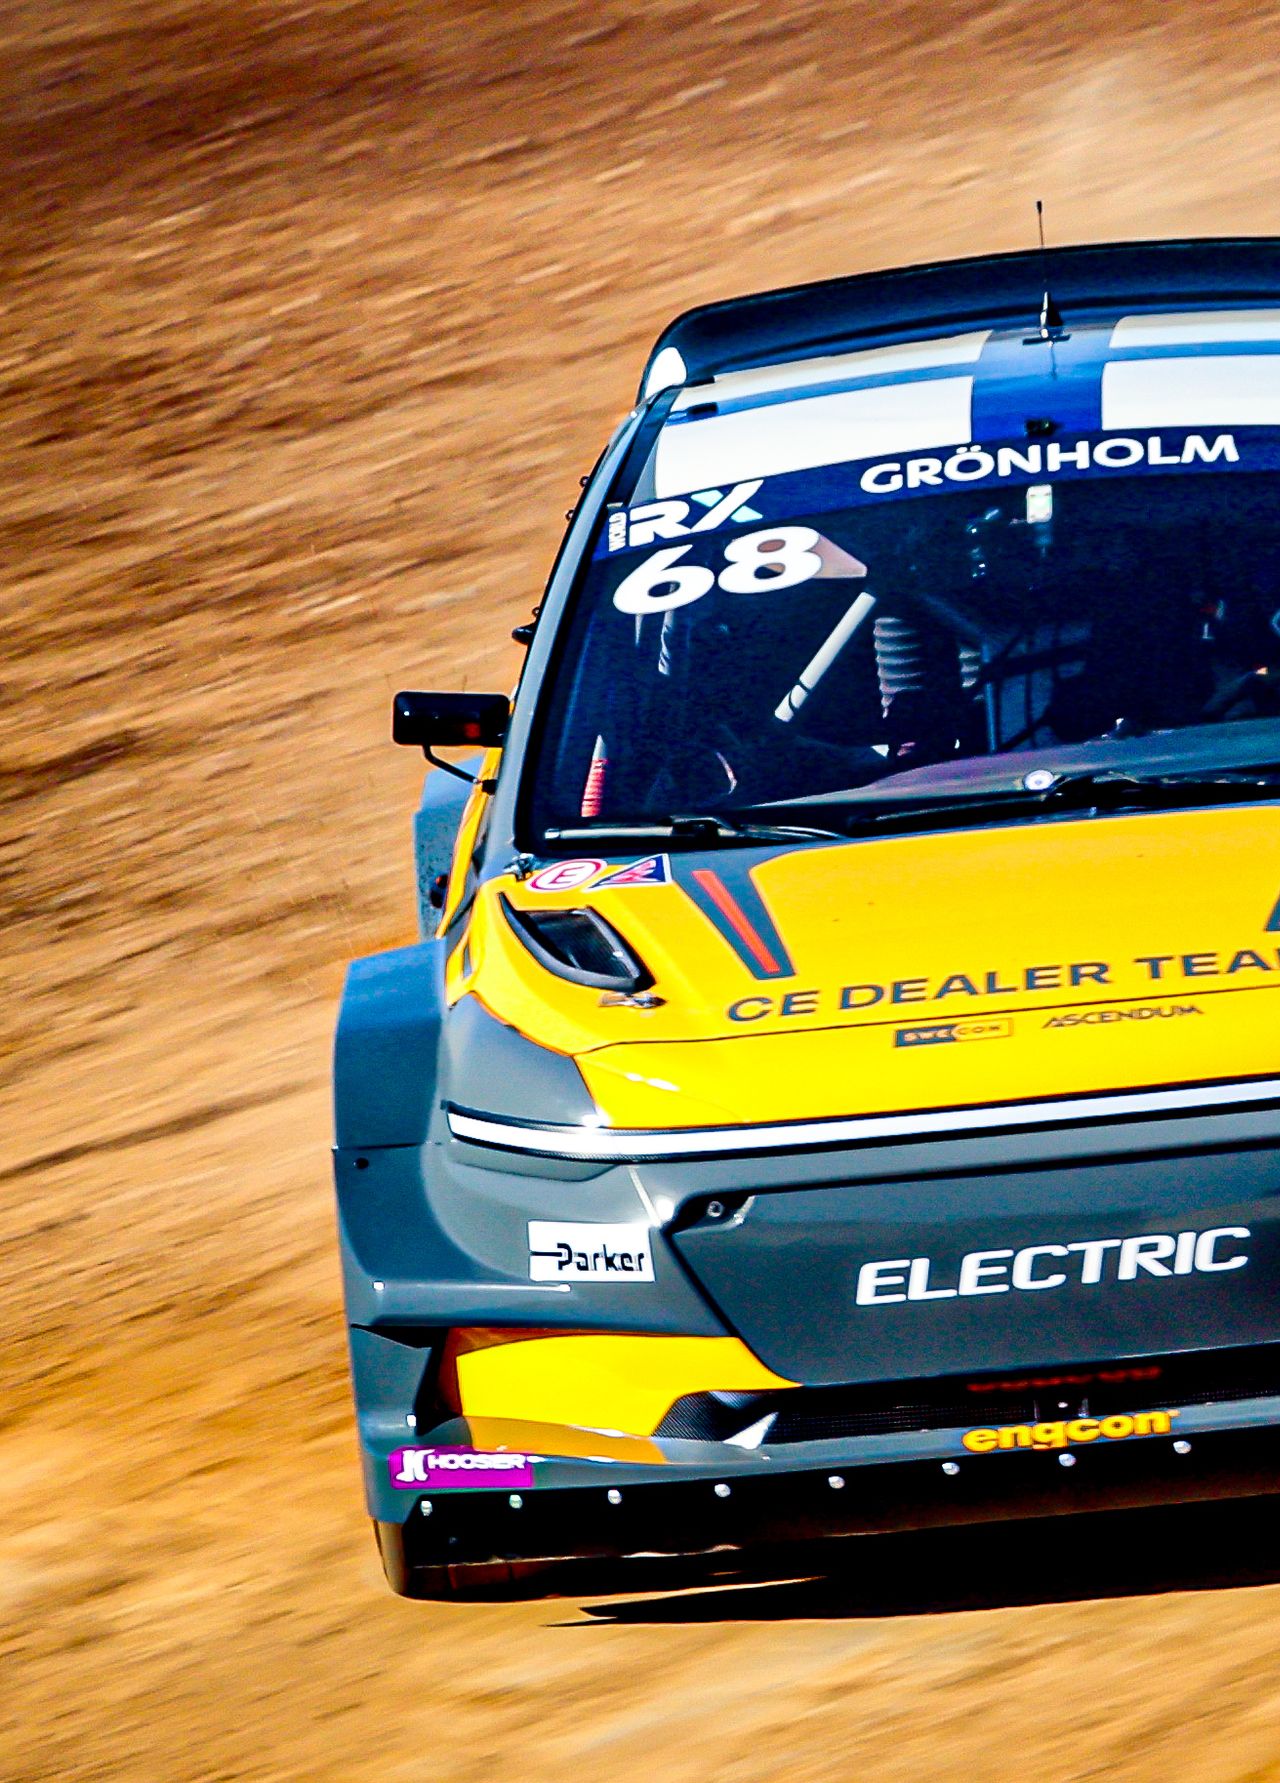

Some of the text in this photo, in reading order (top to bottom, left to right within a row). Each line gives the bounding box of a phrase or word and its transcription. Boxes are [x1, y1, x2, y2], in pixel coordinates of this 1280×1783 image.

[860, 434, 1240, 494] GRÖNHOLM
[629, 480, 764, 547] RX
[613, 526, 822, 615] 68
[726, 990, 821, 1022] CE
[838, 962, 1113, 1011] DEALER
[1042, 1004, 1204, 1029] ASCENDUM
[556, 1242, 645, 1272] Parker
[856, 1227, 1251, 1306] ELECTRIC
[427, 1453, 526, 1470] HOOSIER
[962, 1410, 1173, 1453] engcon
